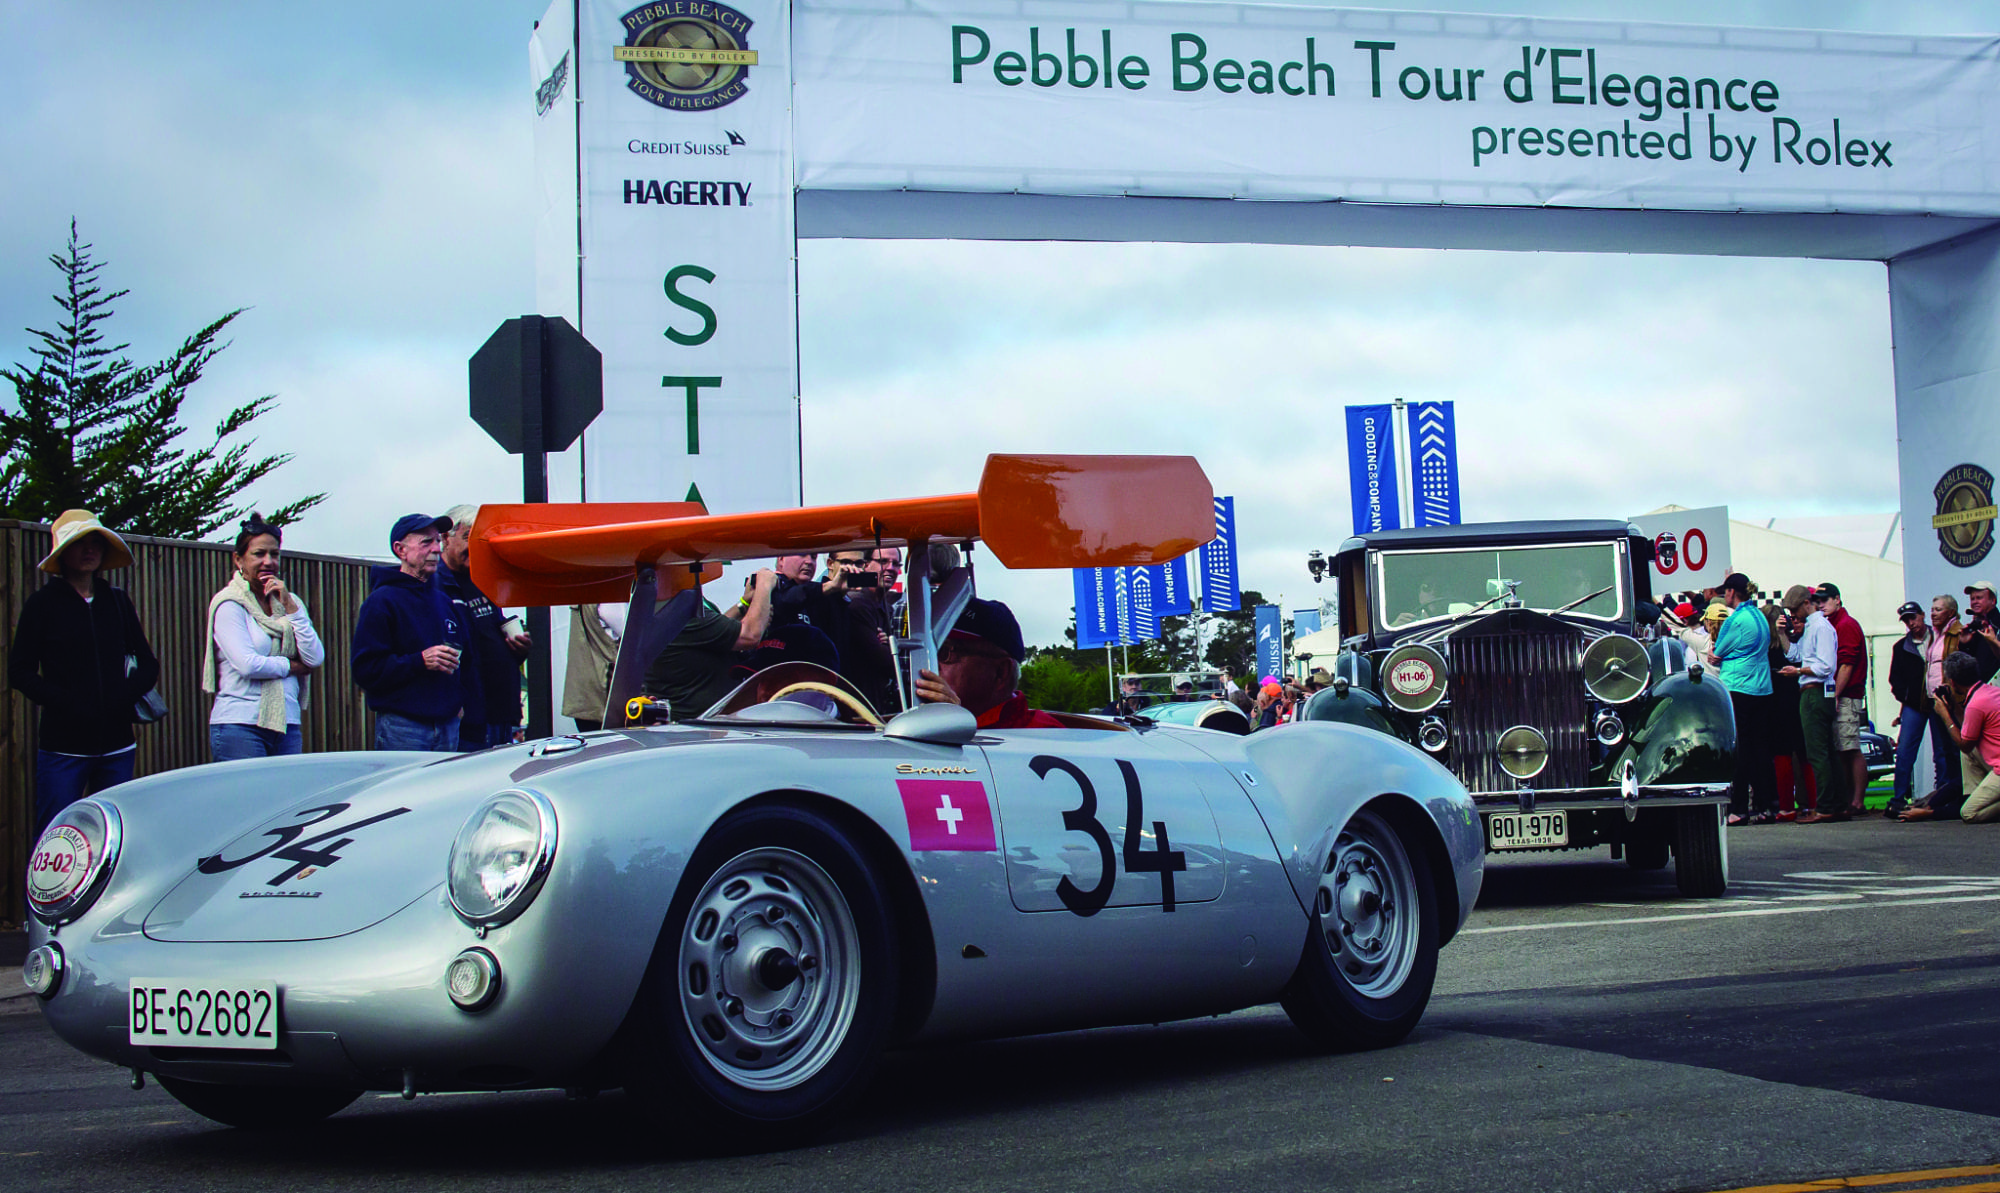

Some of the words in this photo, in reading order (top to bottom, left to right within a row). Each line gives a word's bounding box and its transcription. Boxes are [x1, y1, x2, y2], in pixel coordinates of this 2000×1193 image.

[626, 1, 686, 31] PEBBLE
[689, 2, 747, 33] BEACH
[622, 49, 685, 60] PRESENTED
[691, 52, 705, 60] BY
[710, 52, 746, 61] ROLEX
[951, 25, 1150, 90] Pebble
[1171, 33, 1336, 97] Beach
[1354, 40, 1485, 101] Tour
[1503, 45, 1780, 121] d'Elegance
[631, 79, 665, 104] TOUR
[669, 82, 744, 109] d'ELEGANCE
[627, 139, 682, 154] CREDIT
[683, 140, 731, 156] SUISSE
[1472, 112, 1693, 167] presented
[1708, 113, 1757, 173] by
[1773, 117, 1894, 169] Rolex
[623, 179, 752, 207] HAGERTY
[1364, 417, 1382, 533] GOODING&COMPANY
[1935, 468, 1961, 500] PEBBLE
[1963, 467, 1992, 490] BEACH
[1268, 637, 1280, 677] SUISSE
[1399, 671, 1426, 682] H1-06
[895, 763, 977, 776] Spyder
[63, 828, 86, 852] BEACH
[198, 802, 412, 887] 34
[1028, 754, 1187, 918] 34
[33, 851, 74, 873] 03-02
